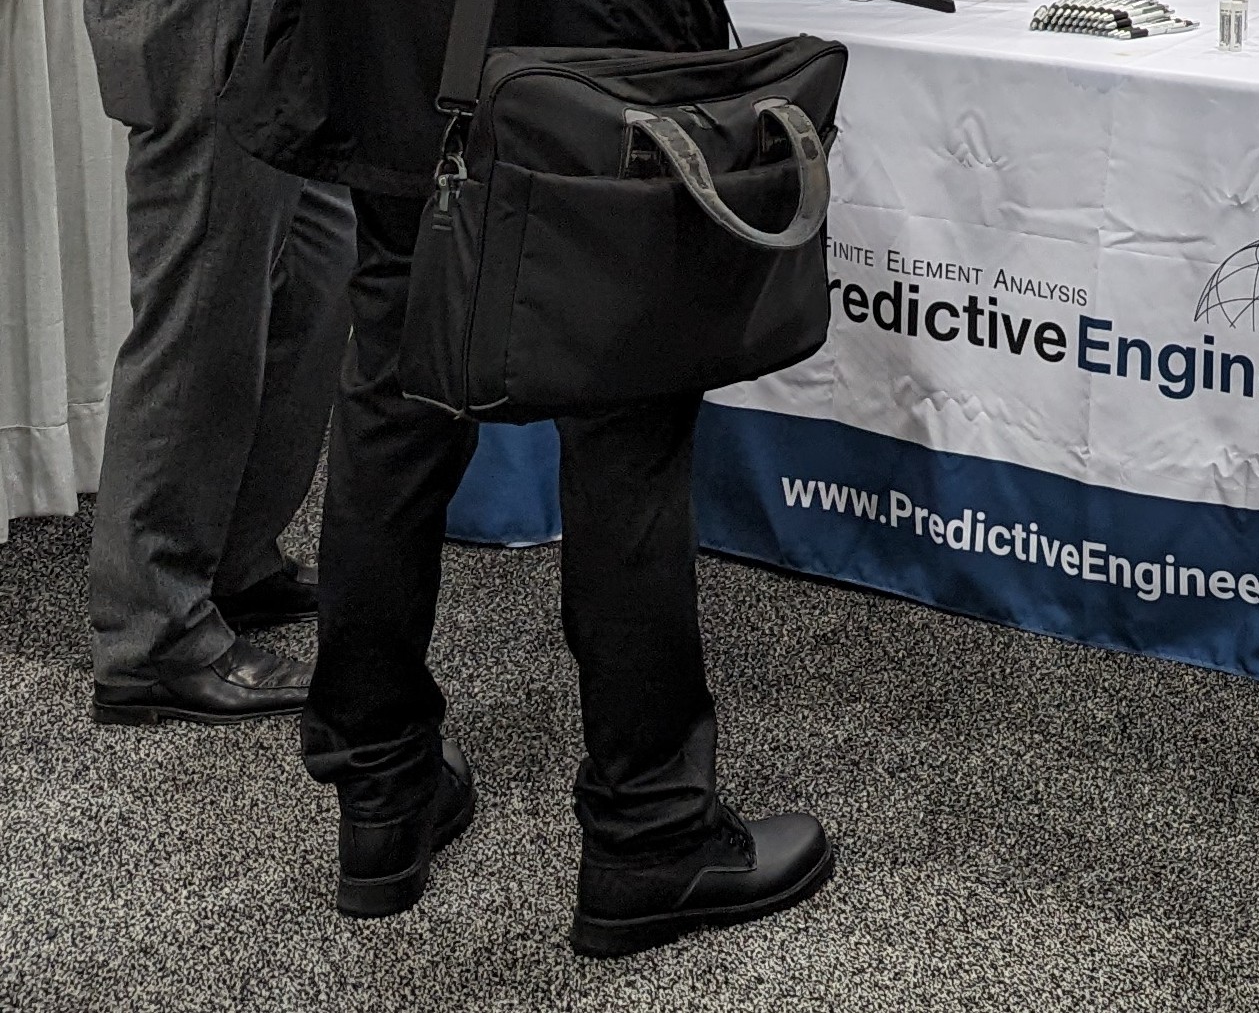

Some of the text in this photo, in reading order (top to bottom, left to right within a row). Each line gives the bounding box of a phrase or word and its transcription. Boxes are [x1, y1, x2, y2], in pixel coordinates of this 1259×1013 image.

[886, 249, 983, 286] ELEMENT
[993, 268, 1088, 307] ANALYSIS
[828, 276, 1067, 363] redictive
